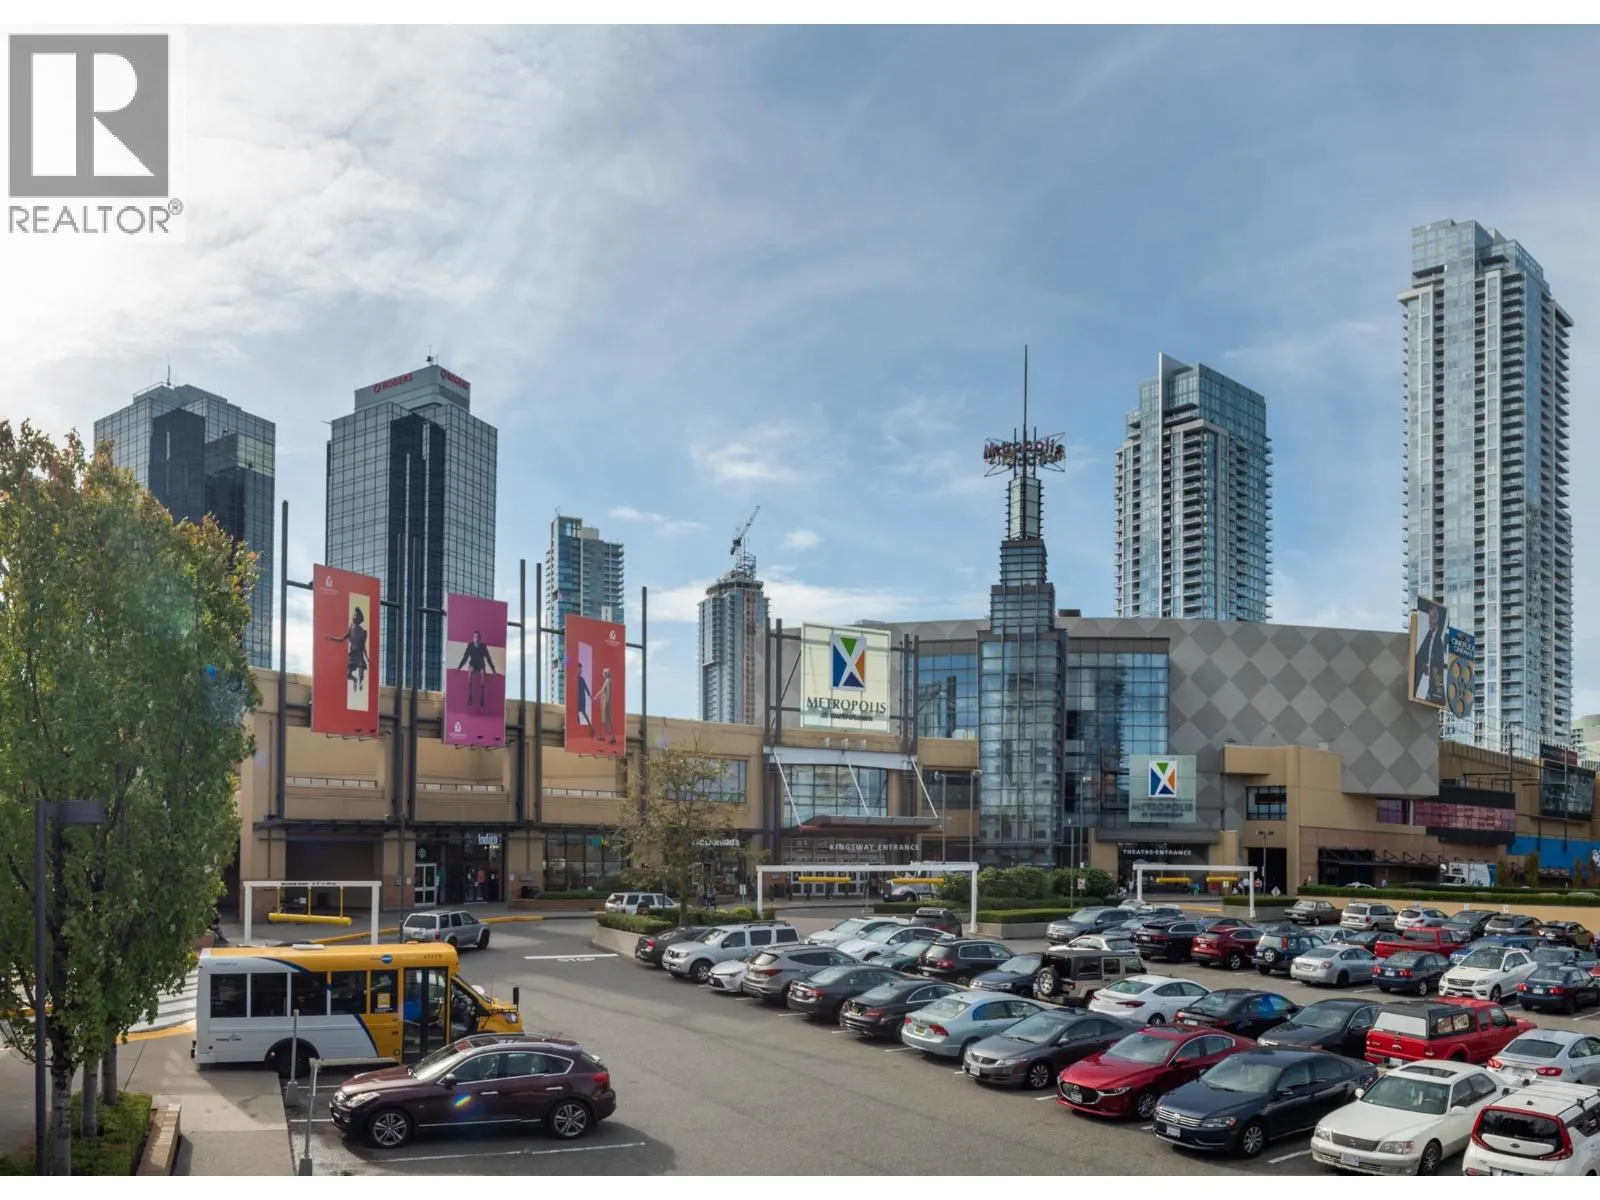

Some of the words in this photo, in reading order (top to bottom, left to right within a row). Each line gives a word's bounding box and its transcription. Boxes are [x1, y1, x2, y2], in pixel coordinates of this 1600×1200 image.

[806, 696, 887, 713] METROPOLIS
[477, 832, 499, 846] Indigo
[877, 843, 921, 852] ENTRANCE
